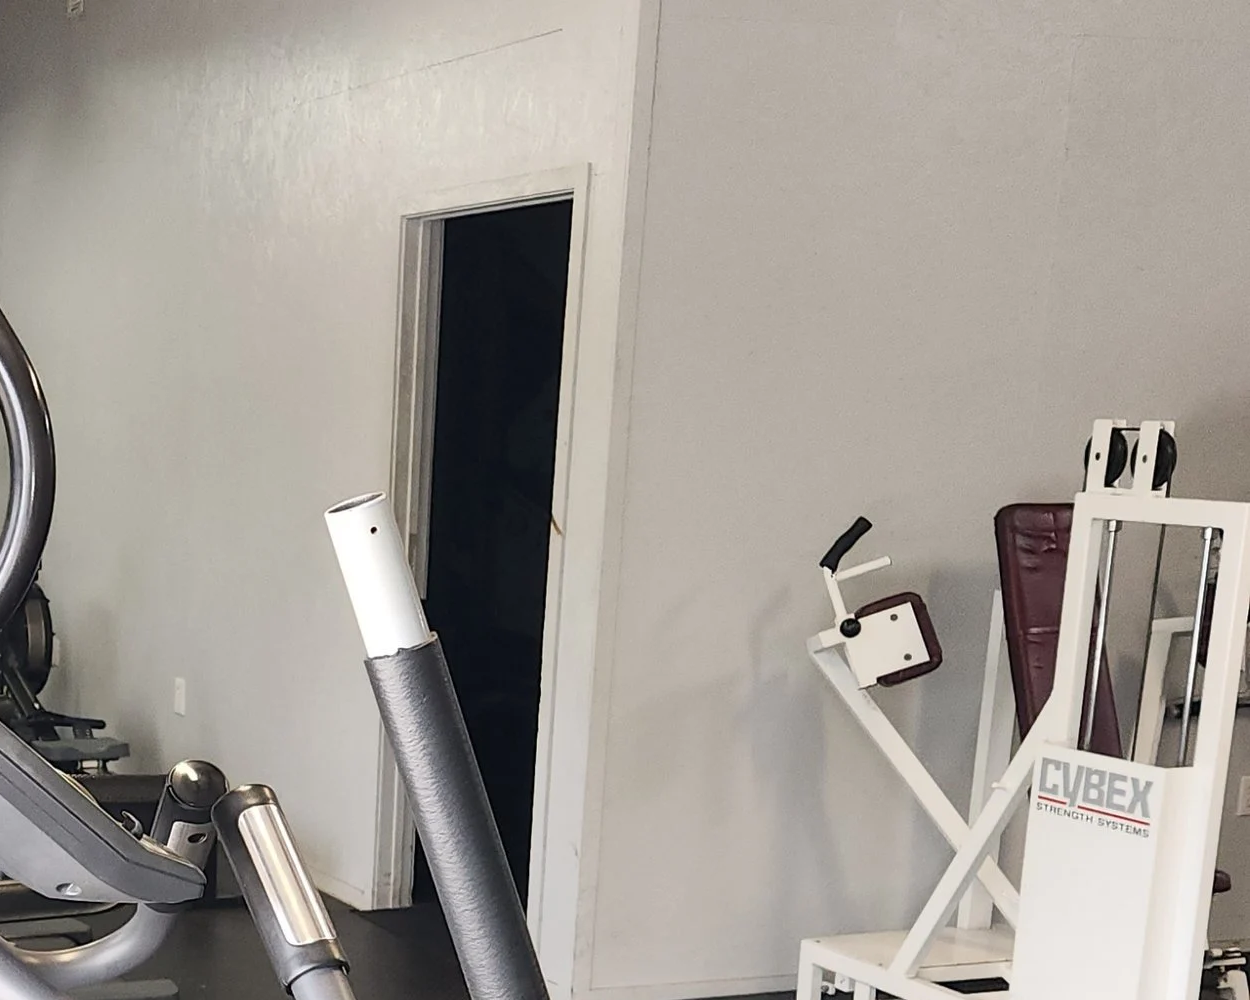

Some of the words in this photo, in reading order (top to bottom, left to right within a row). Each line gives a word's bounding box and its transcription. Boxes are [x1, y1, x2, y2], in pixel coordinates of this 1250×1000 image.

[1038, 757, 1154, 819] CYBEX
[1036, 801, 1094, 824] STRENGTH
[1097, 817, 1150, 839] SYSTEMS
